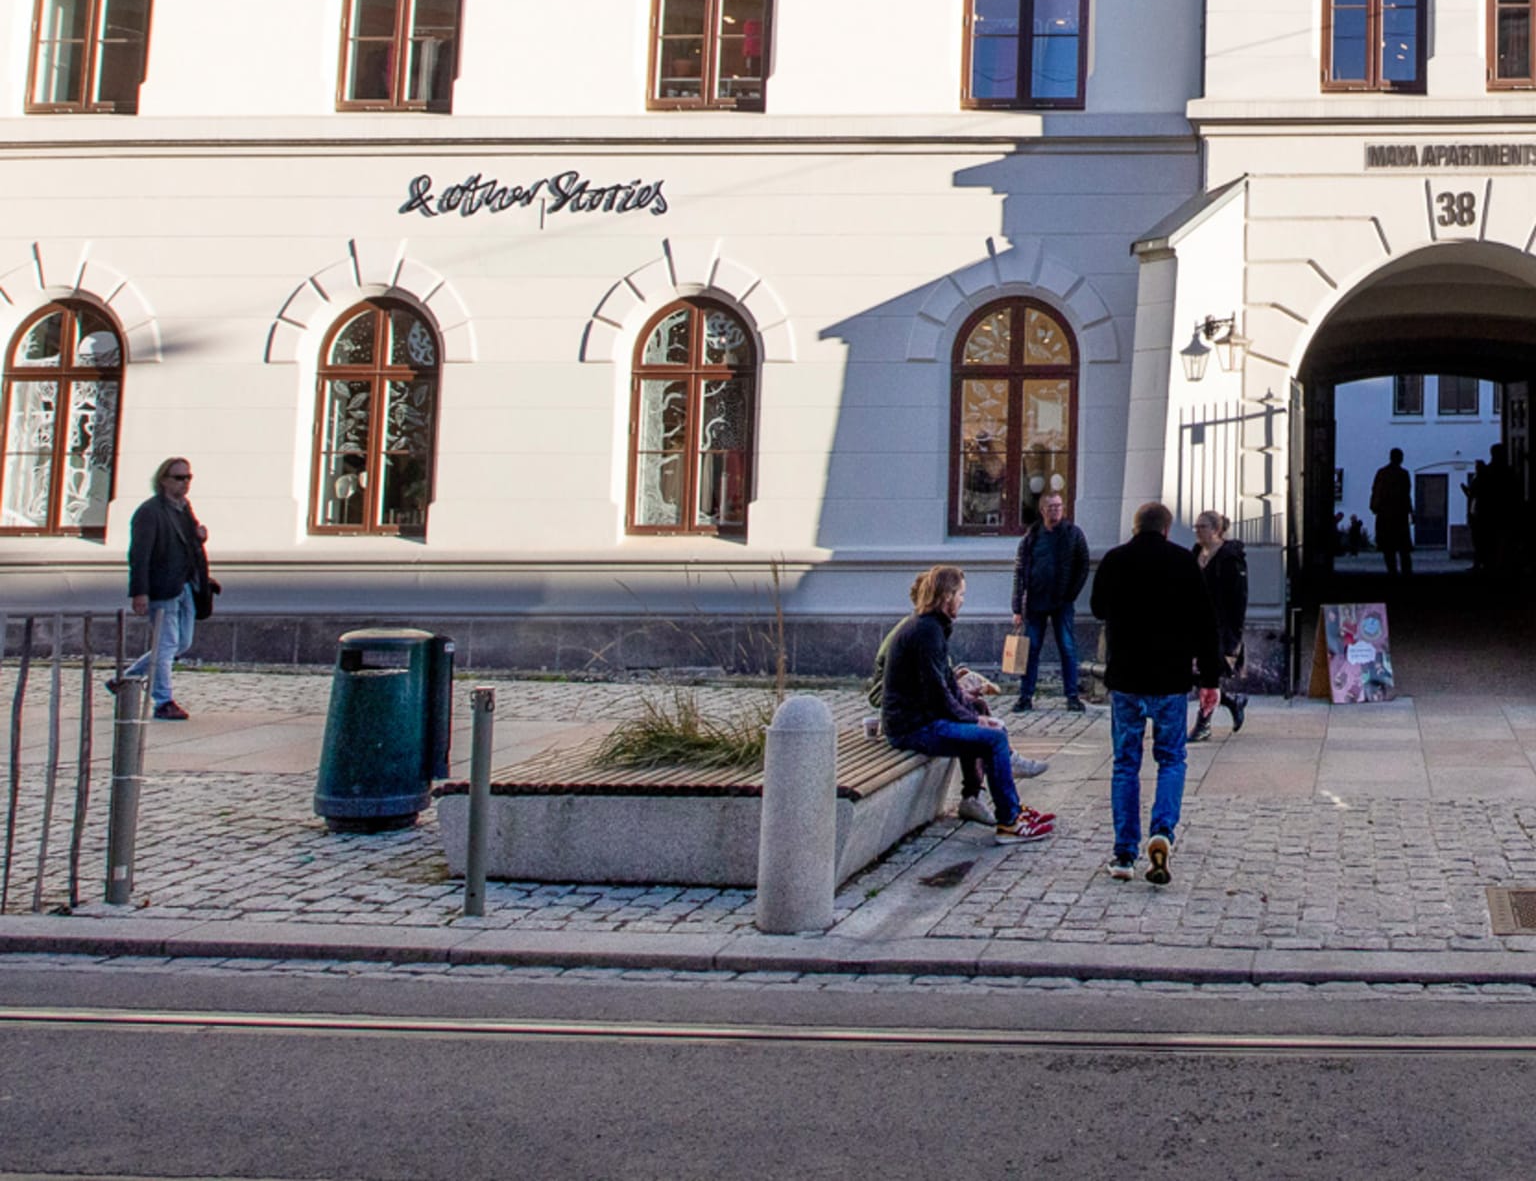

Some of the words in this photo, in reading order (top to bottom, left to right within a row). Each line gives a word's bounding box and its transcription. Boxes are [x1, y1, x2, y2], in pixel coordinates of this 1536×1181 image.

[1367, 145, 1418, 168] MAYA
[399, 175, 438, 217] &
[547, 171, 669, 216] Stories
[1435, 191, 1476, 227] 38
